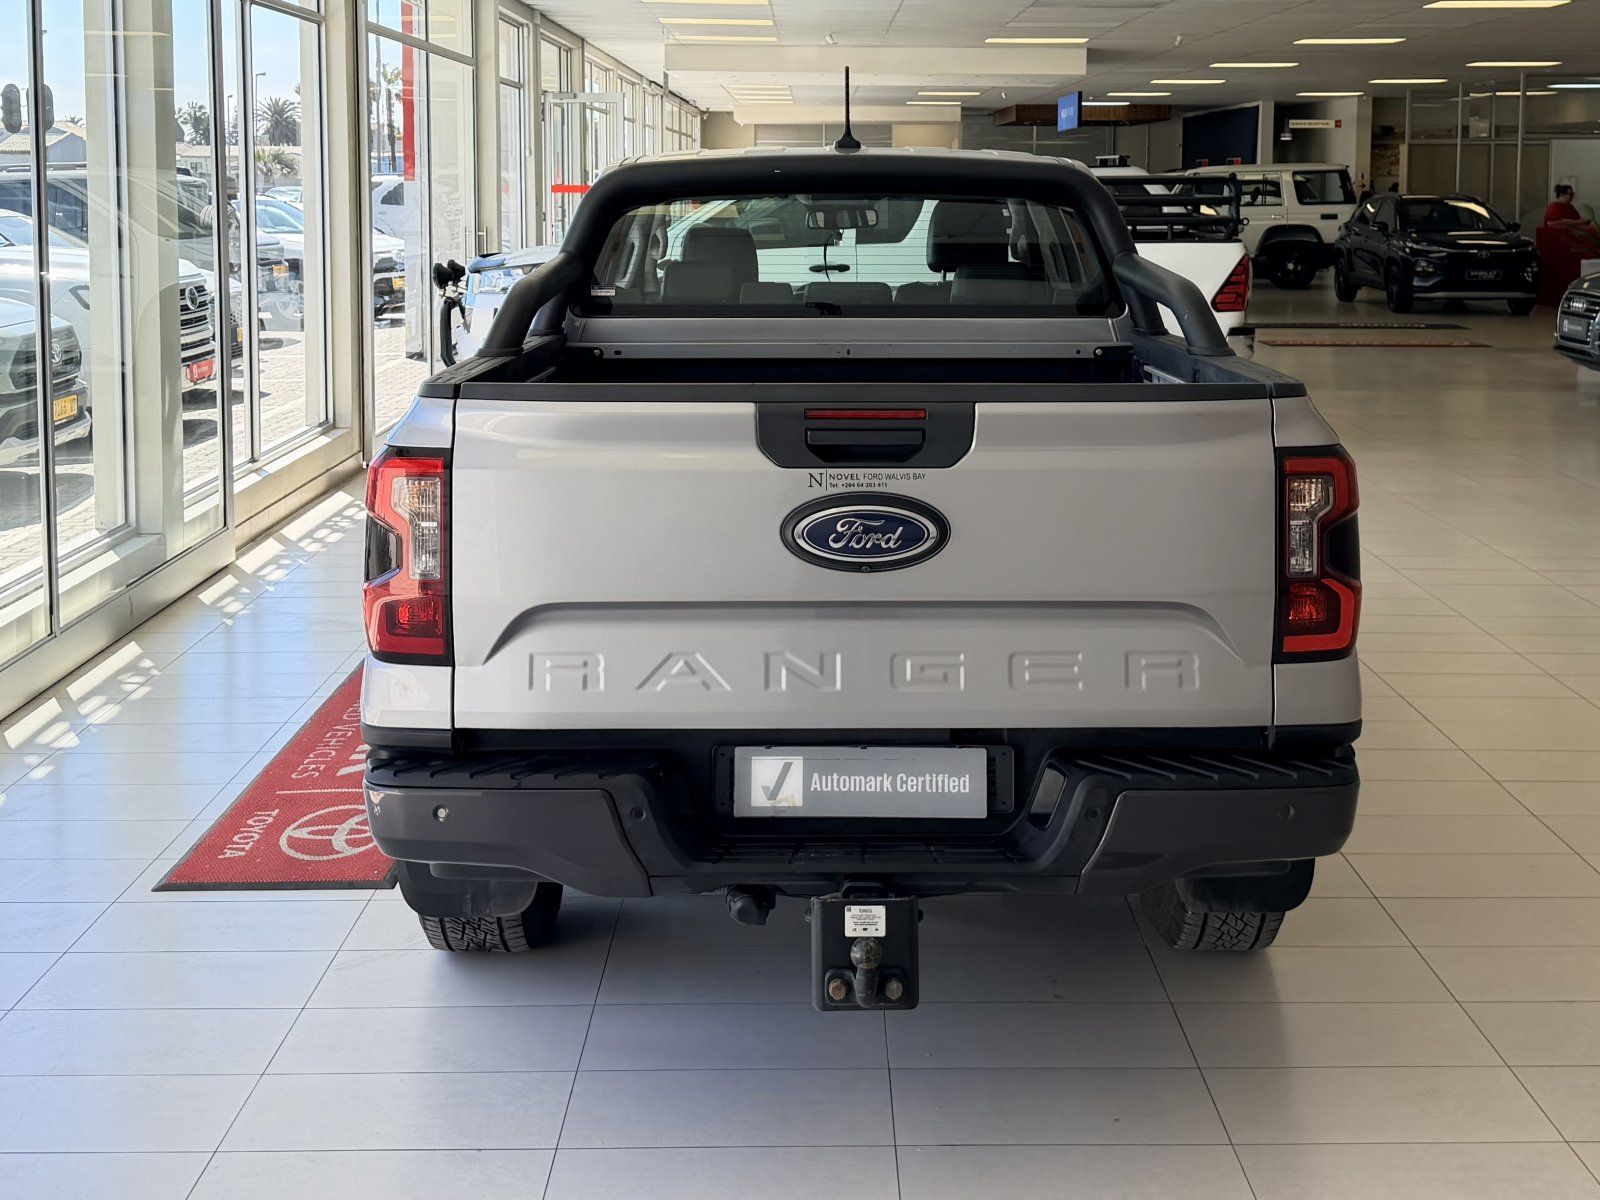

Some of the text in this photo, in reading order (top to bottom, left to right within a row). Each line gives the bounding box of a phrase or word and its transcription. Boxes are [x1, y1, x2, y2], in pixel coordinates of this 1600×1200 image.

[808, 472, 824, 487] N
[828, 517, 904, 549] Ford
[528, 651, 1201, 692] RANGER
[291, 722, 361, 778] VEHICLES
[810, 772, 970, 793] Automark Certified
[217, 808, 280, 859] TOYOTA
